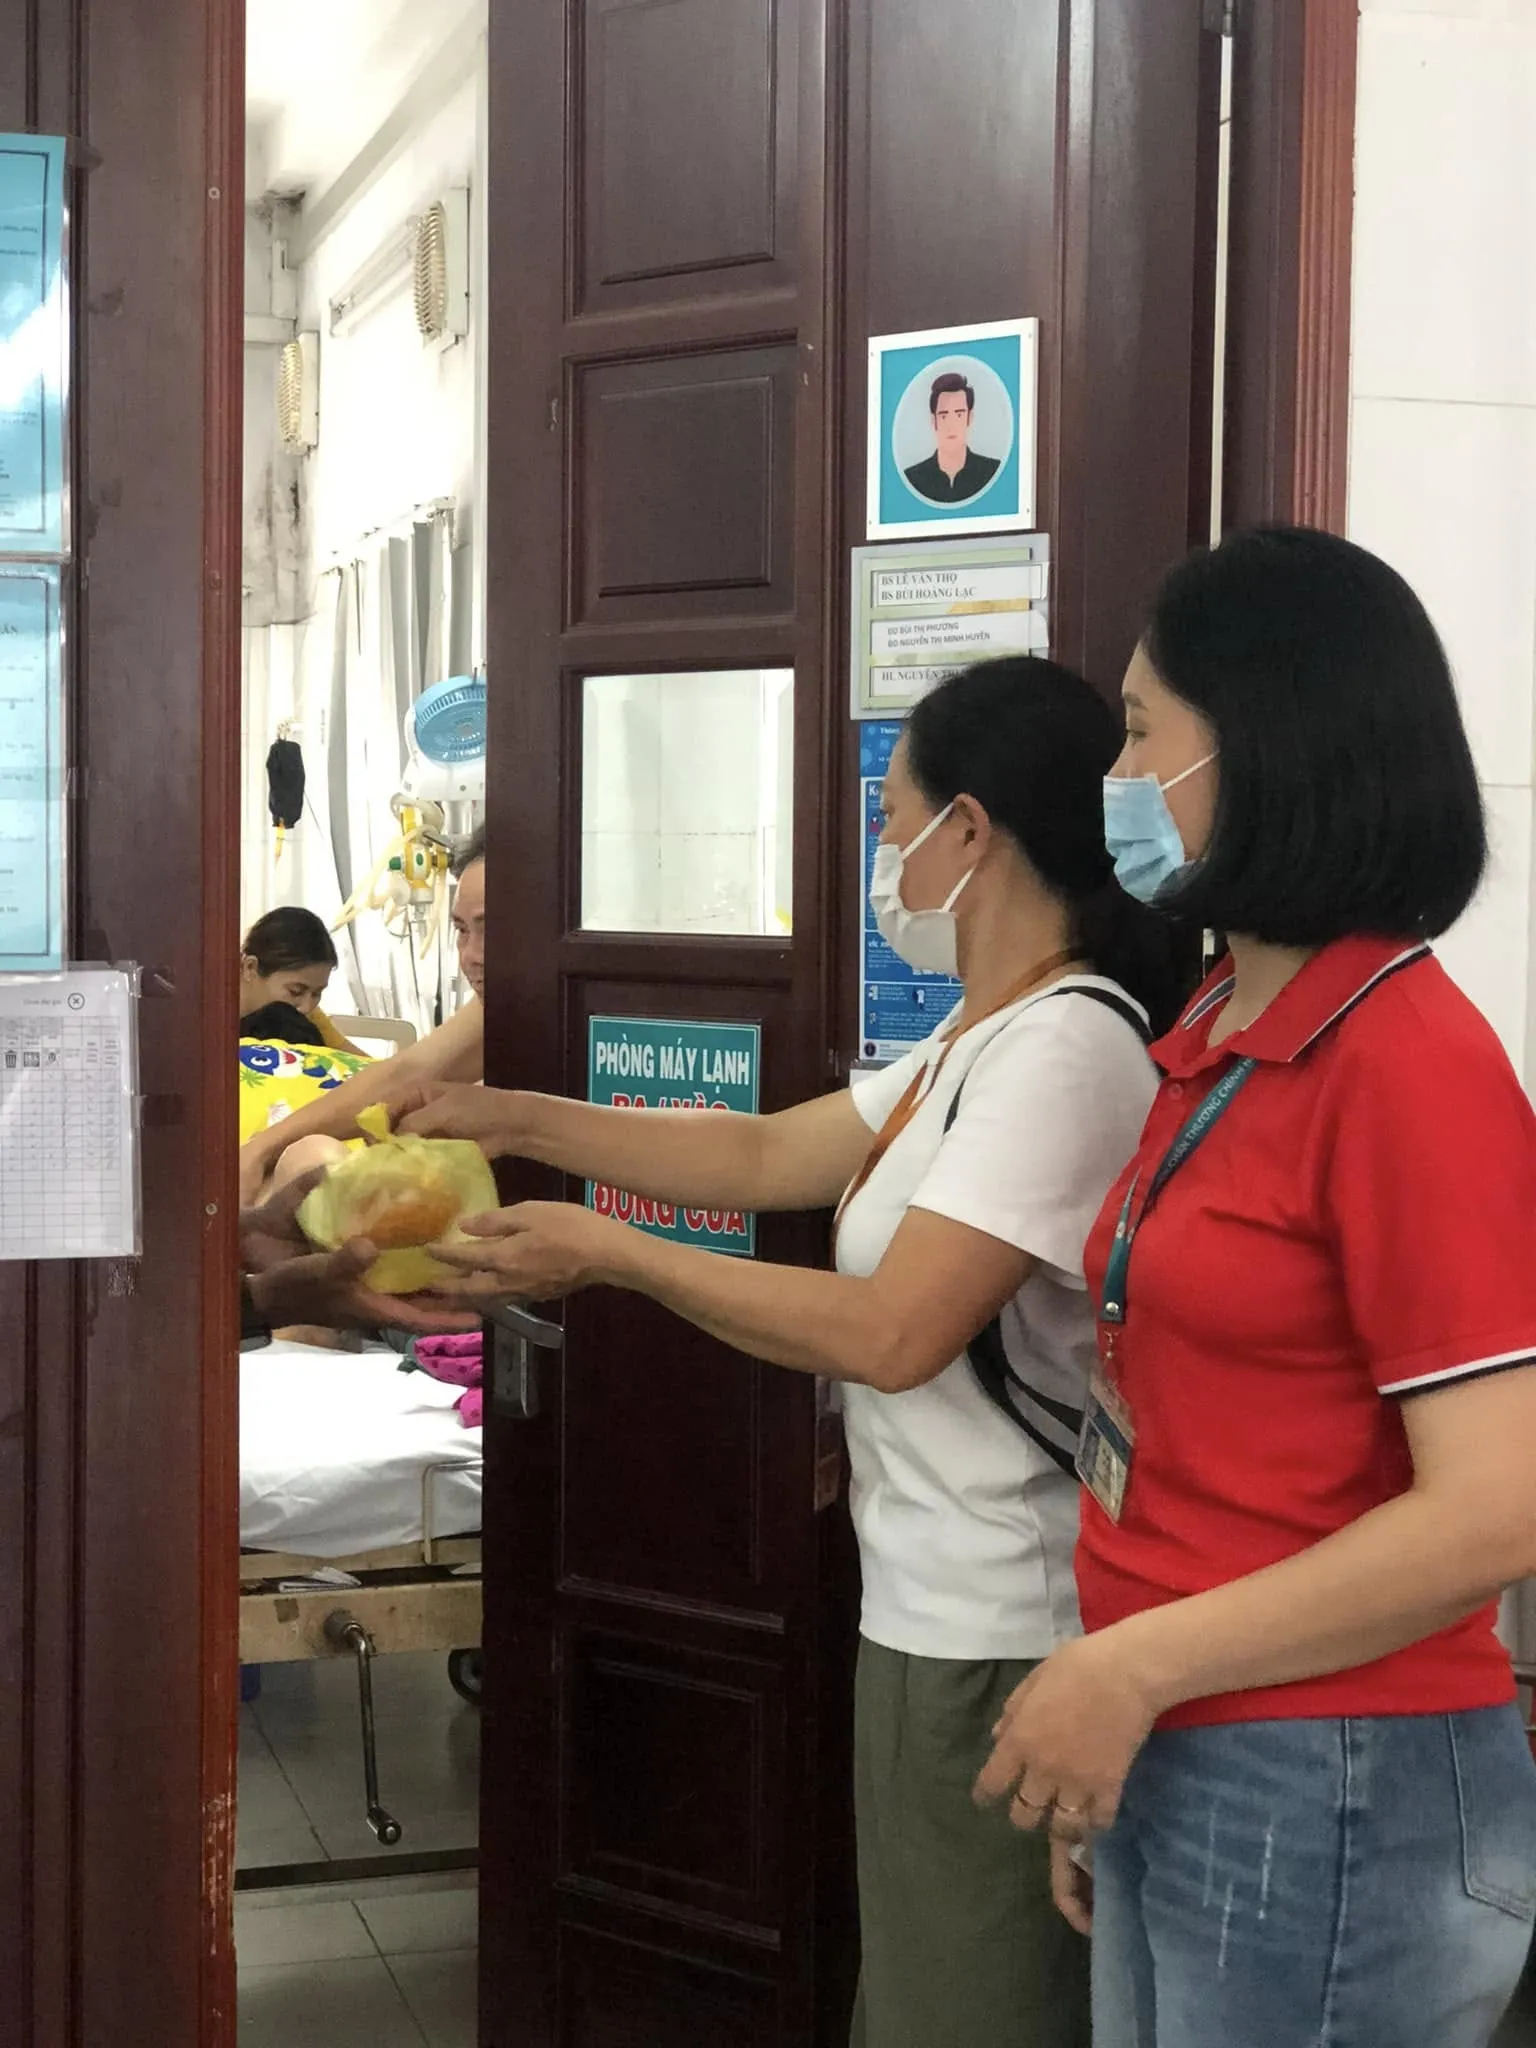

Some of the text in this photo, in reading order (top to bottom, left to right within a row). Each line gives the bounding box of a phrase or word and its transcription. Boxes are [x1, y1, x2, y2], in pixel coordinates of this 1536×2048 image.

[596, 1034, 750, 1093] PHÒNG MÁY LẠNH
